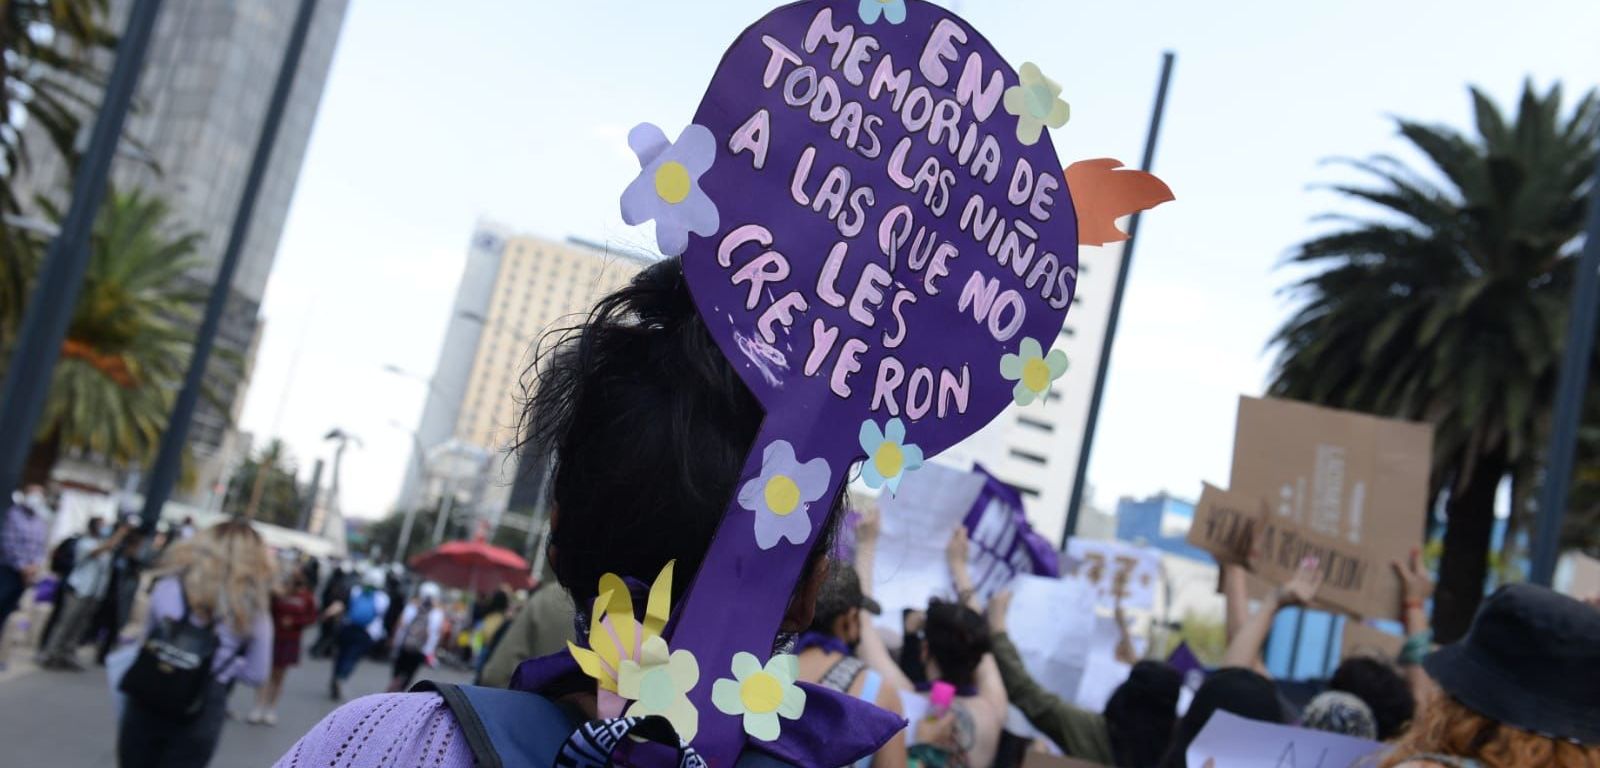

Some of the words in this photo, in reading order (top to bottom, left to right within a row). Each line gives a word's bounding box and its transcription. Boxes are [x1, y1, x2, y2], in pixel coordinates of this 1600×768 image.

[762, 34, 883, 158] TODAS
[888, 136, 955, 216] LAS
[960, 193, 1076, 309] NIÑAS
[803, 7, 1001, 184] MEMORIA
[1007, 157, 1059, 220] DE
[919, 18, 1004, 122] EN
[728, 109, 770, 170] A
[790, 147, 875, 237] LAS
[878, 204, 959, 295] QUE
[958, 269, 1027, 341] NO
[815, 241, 917, 348] LES
